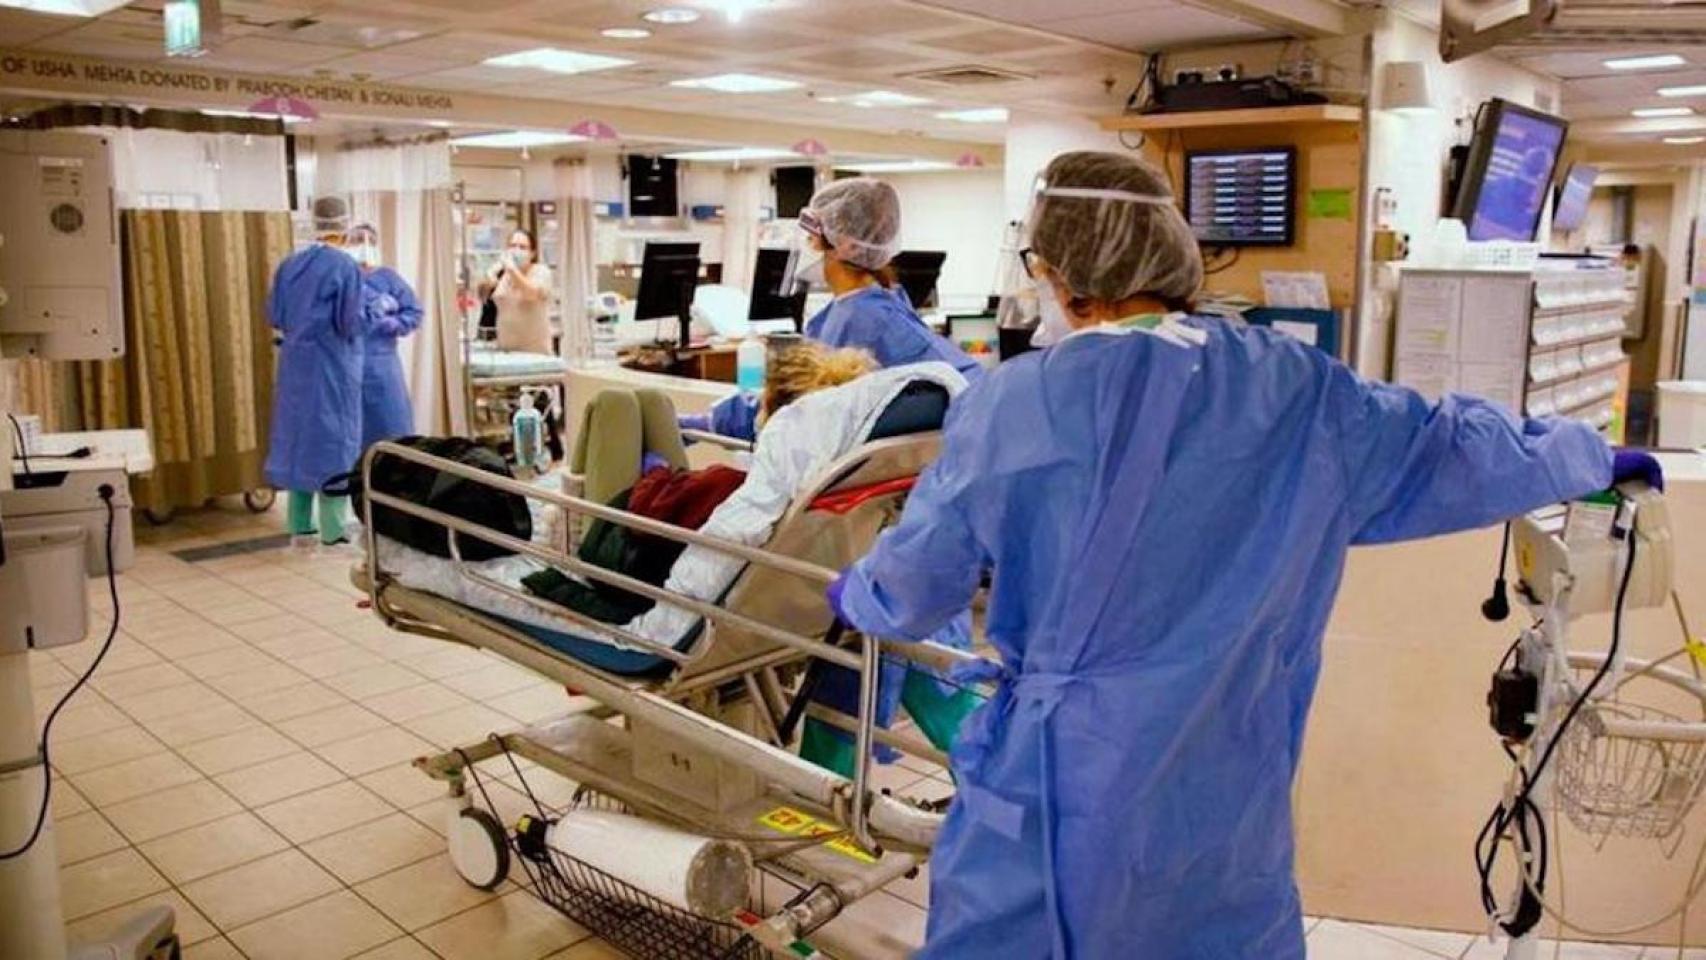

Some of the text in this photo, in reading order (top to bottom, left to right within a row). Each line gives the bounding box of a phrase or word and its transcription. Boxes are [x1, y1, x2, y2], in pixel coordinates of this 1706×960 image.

[2, 56, 29, 74] OF
[32, 61, 77, 78] USHA
[84, 65, 136, 83] MEHTA
[139, 69, 211, 90] DONATED
[213, 77, 230, 92] BY
[304, 85, 353, 102] CHETAN
